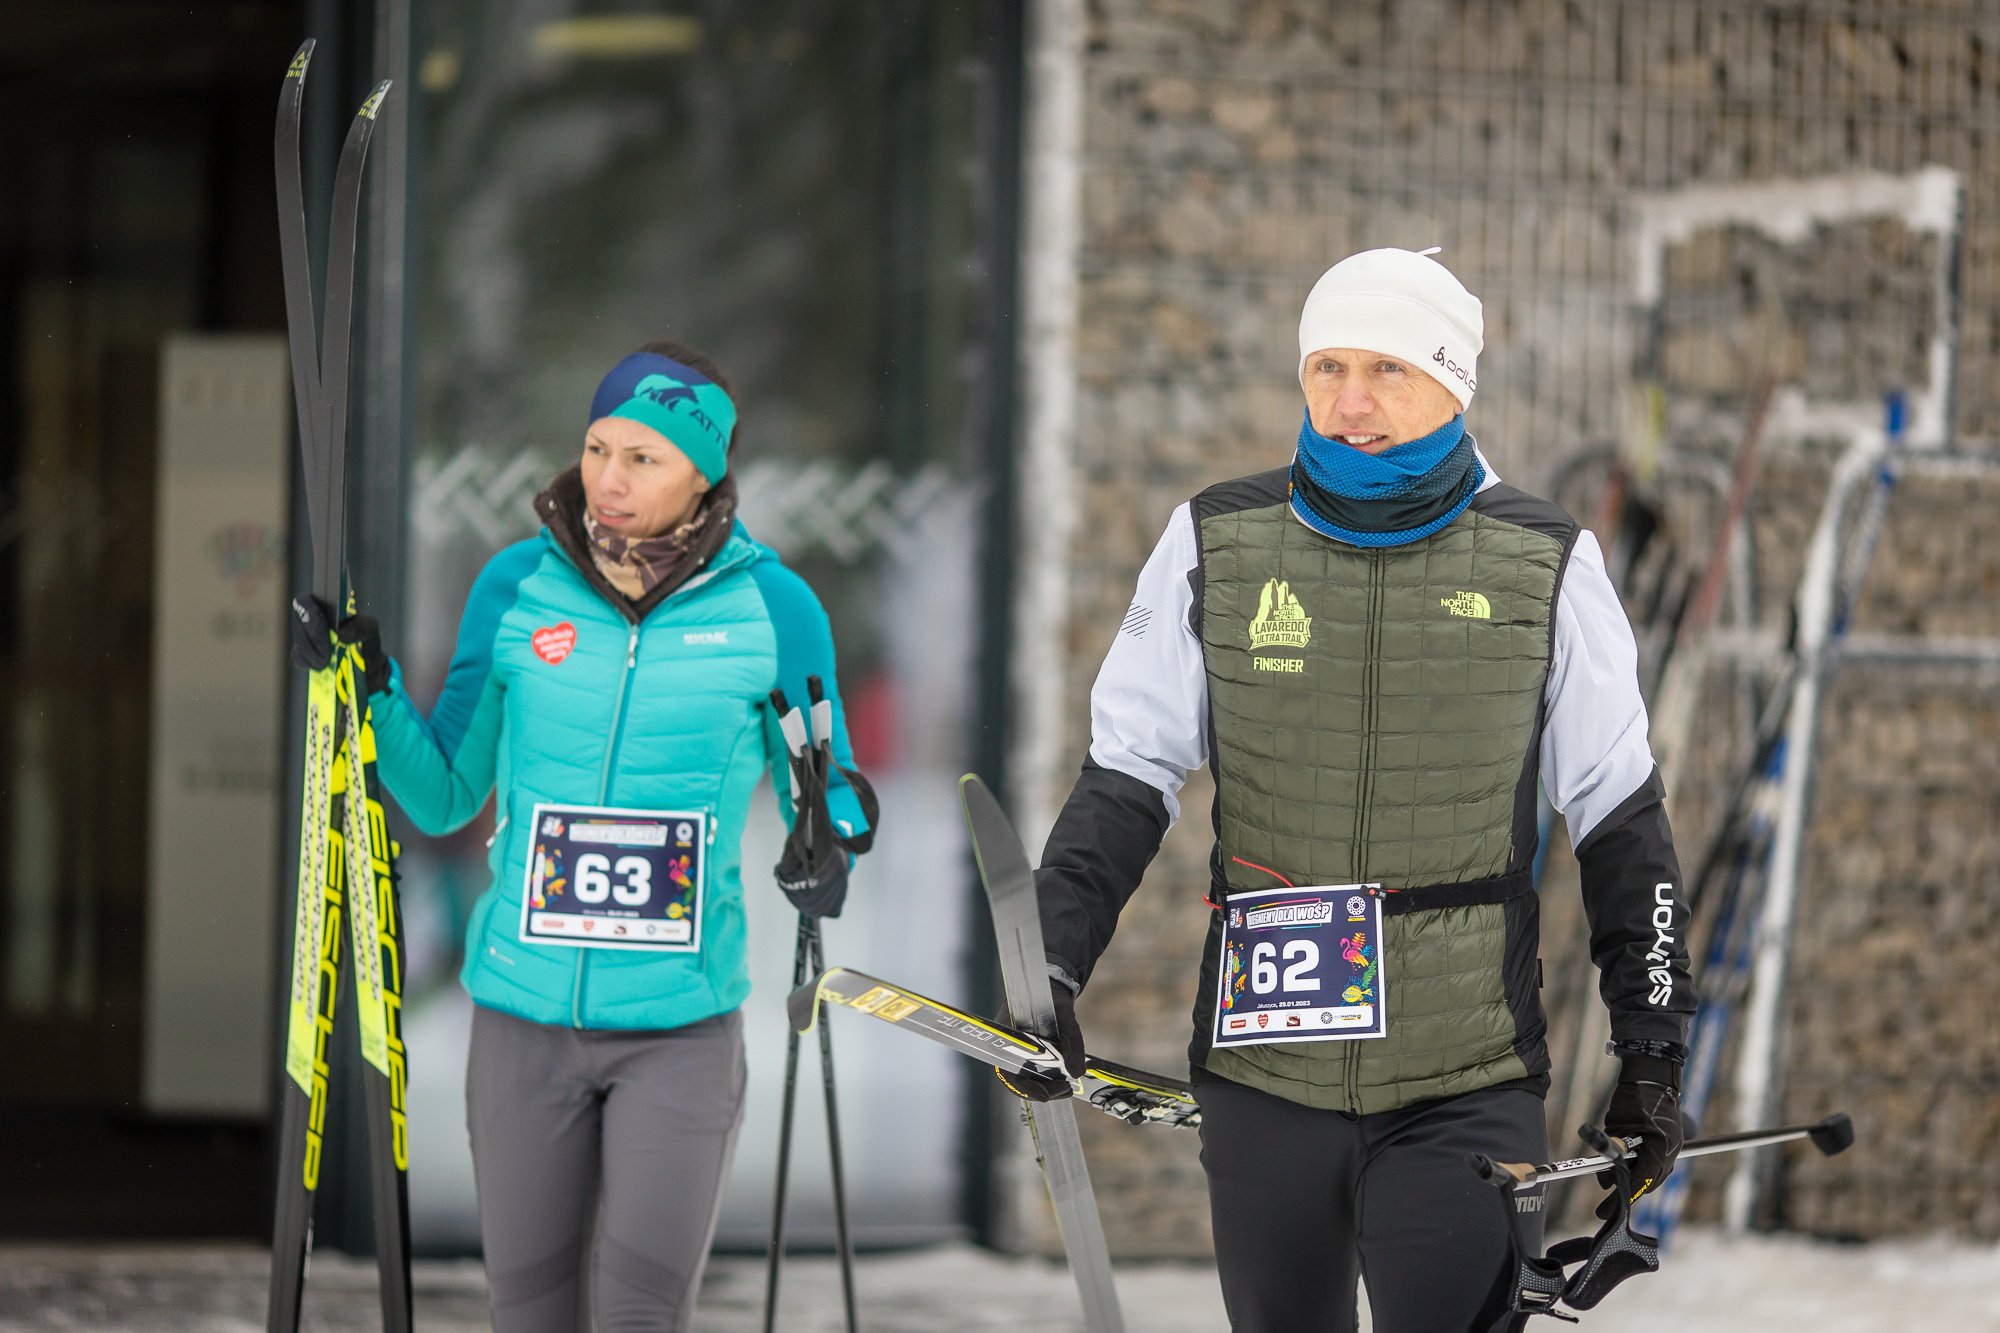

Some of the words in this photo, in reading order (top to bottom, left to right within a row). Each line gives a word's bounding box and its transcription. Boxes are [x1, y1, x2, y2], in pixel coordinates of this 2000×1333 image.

[1440, 598, 1474, 609] NORTH
[1456, 590, 1475, 600] THE
[1450, 607, 1475, 617] FACE
[1255, 621, 1305, 635] LAVAREDO
[1253, 656, 1304, 673] FINISHER
[574, 853, 652, 906] 63
[1277, 908, 1295, 923] DLA
[1297, 902, 1330, 921] WOŚP
[1251, 939, 1321, 995] 62
[365, 798, 409, 1171] FISCHER
[303, 826, 346, 1190] FISCHER
[1278, 1000, 1311, 1008] 29.01.2023
